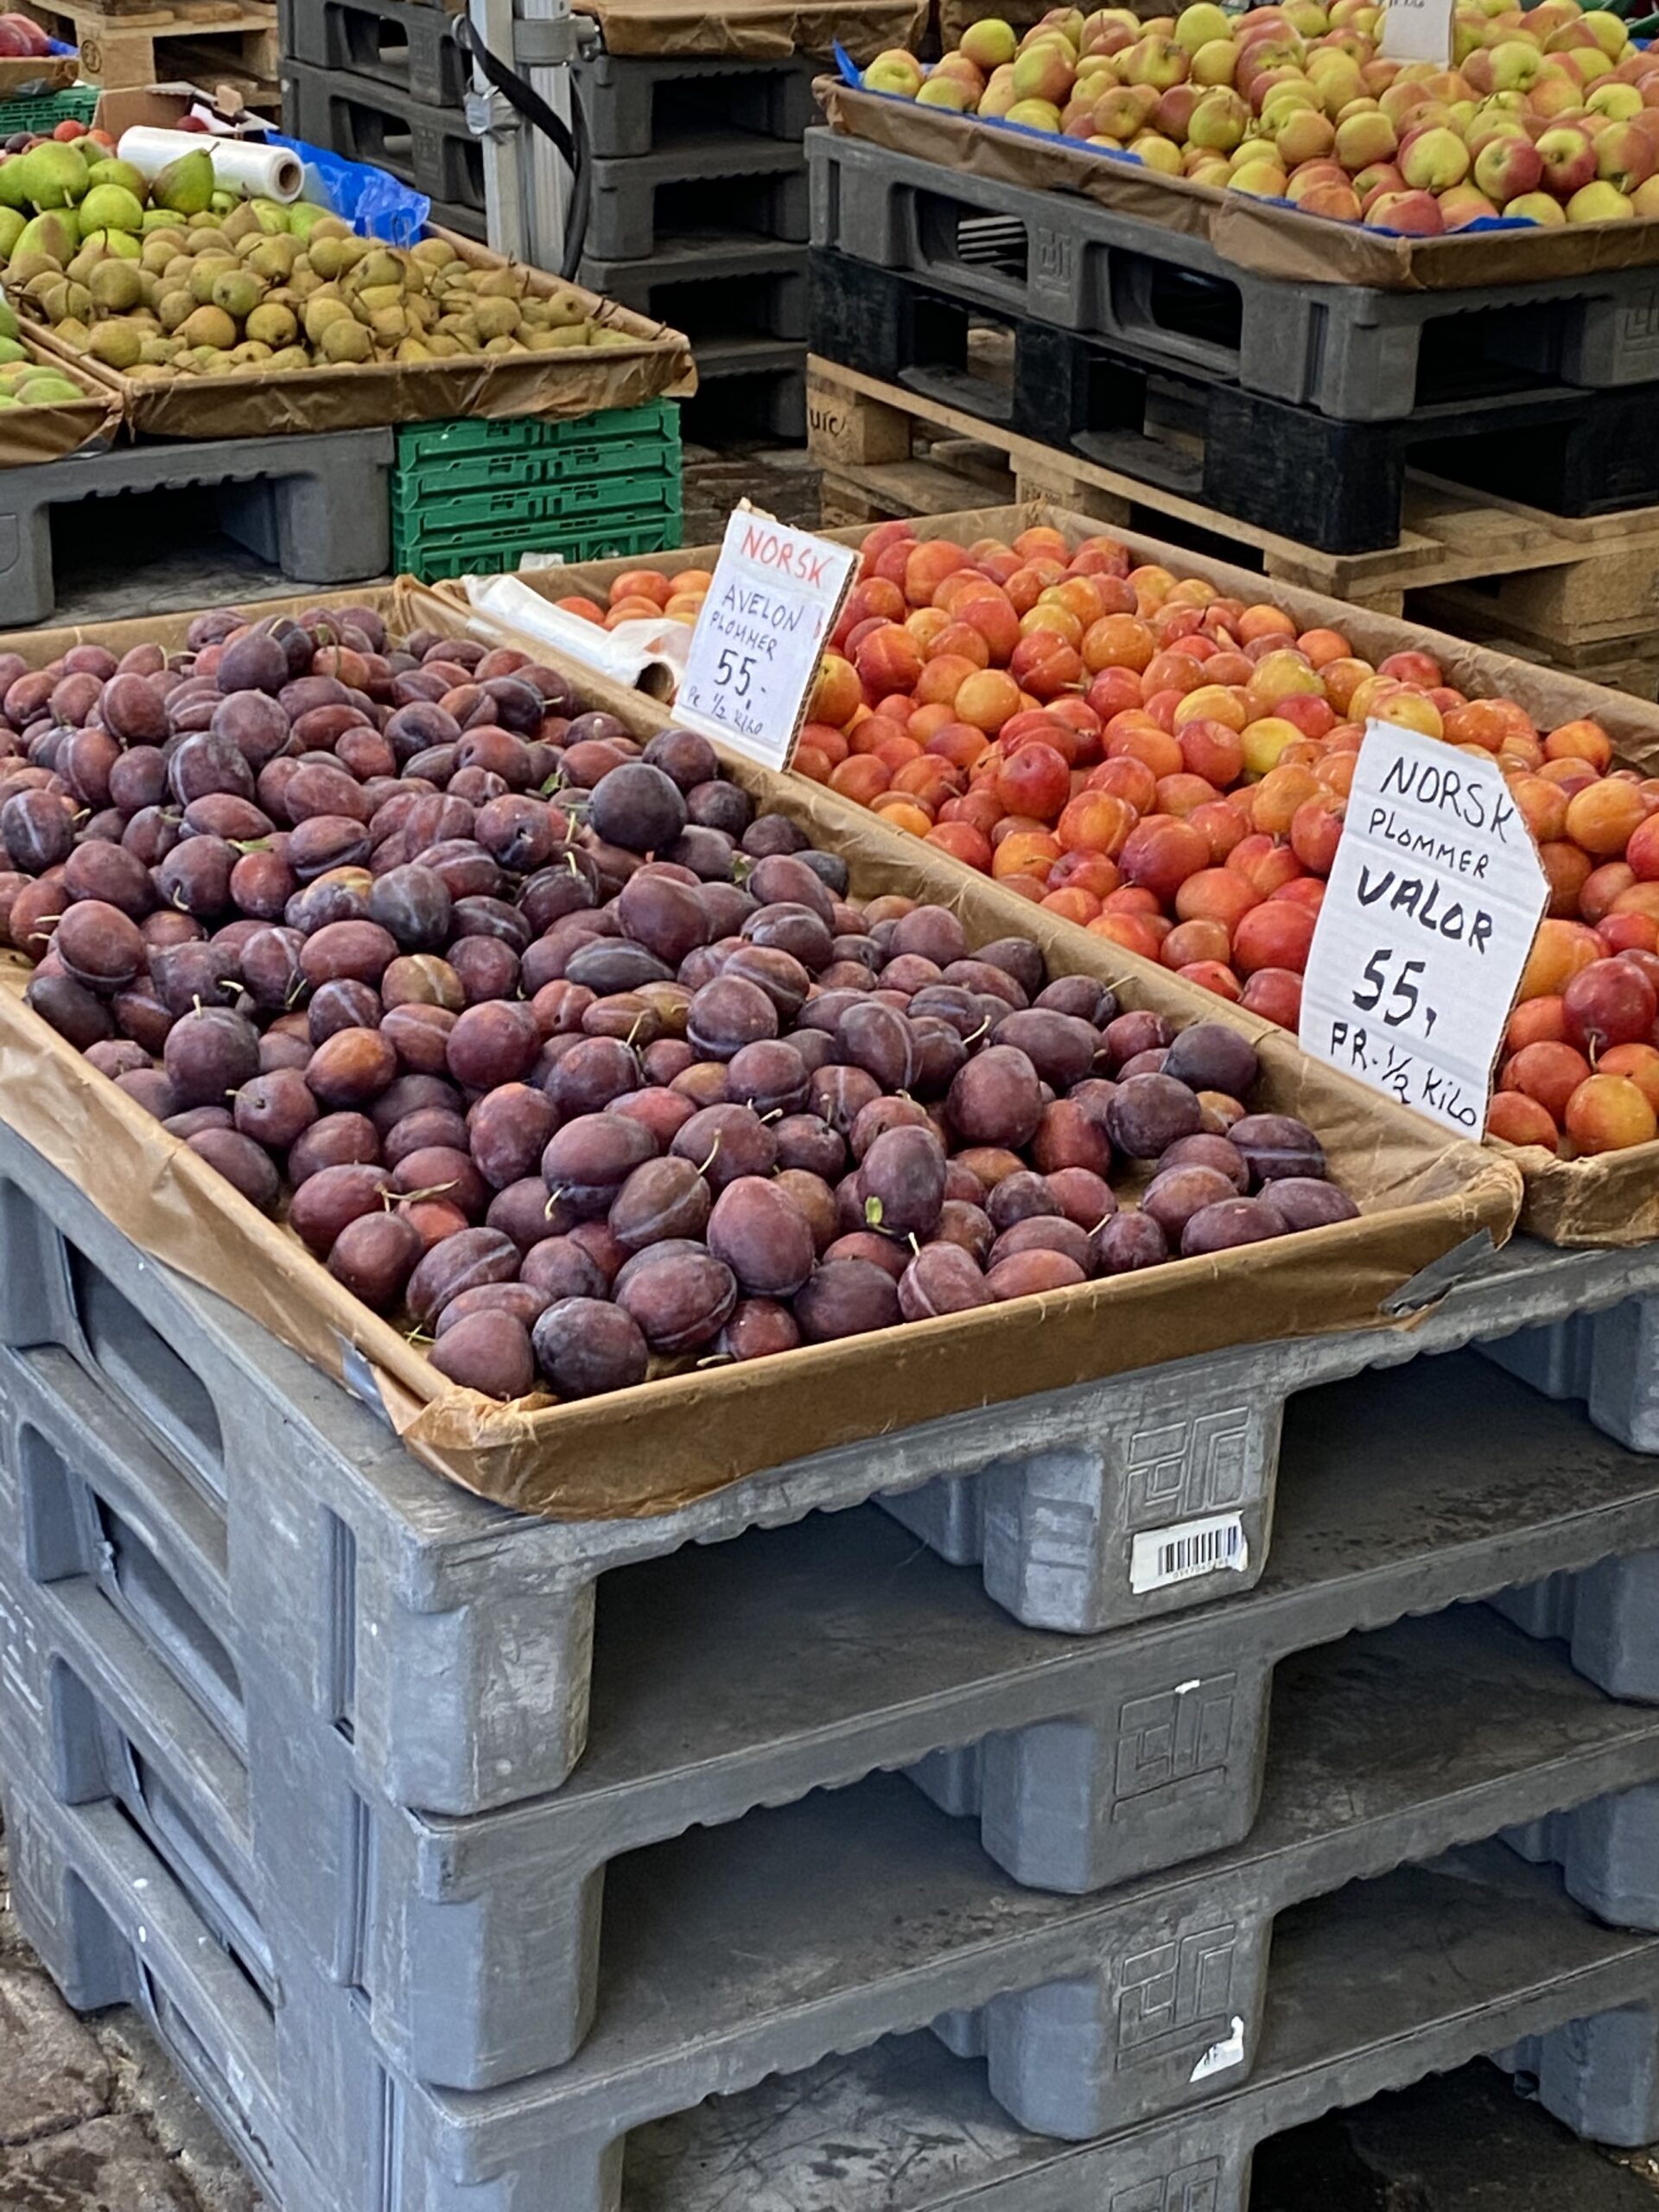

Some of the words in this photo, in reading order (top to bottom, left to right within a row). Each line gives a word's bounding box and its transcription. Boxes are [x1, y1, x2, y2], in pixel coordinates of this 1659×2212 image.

[741, 525, 833, 588] NORSK
[709, 611, 778, 661] PLOMMER
[721, 584, 804, 632] AVELON
[1380, 757, 1514, 843] NORSK
[1369, 808, 1490, 879] PLOMMER
[1357, 865, 1493, 954] VALOR
